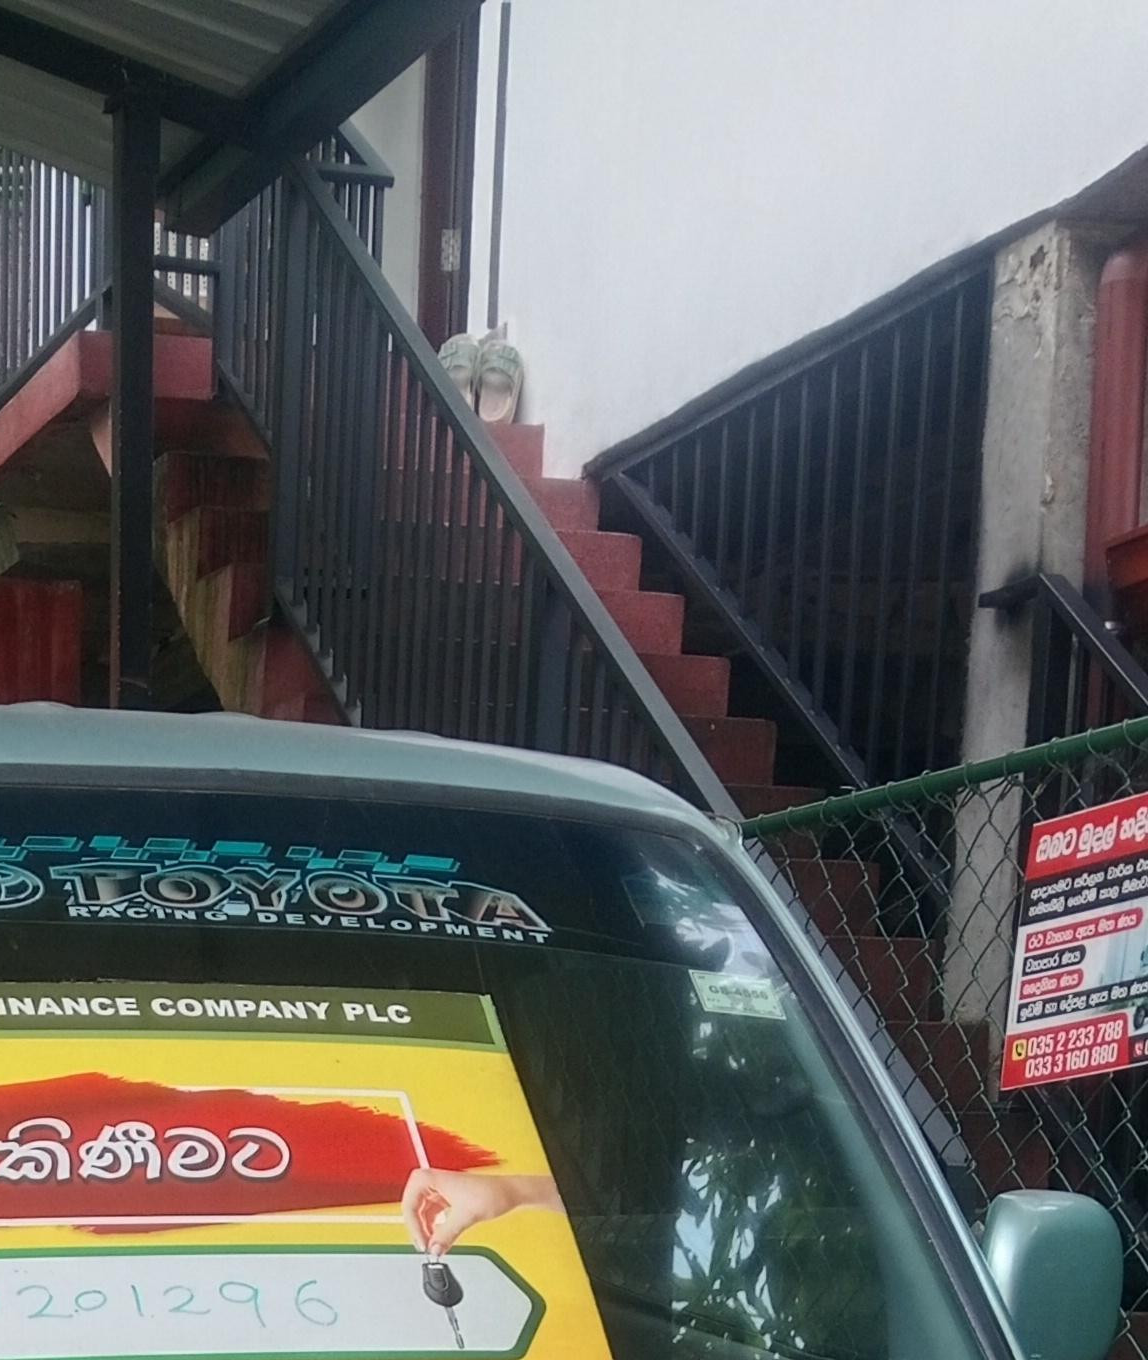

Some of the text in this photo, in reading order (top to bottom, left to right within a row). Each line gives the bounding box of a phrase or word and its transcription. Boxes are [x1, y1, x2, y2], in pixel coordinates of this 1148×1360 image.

[50, 861, 553, 932] TOYOTA
[68, 904, 549, 943] RACING DEVELOPMENT
[151, 1000, 331, 1021] COMPANY
[342, 1003, 412, 1024] PLC
[1028, 1020, 1123, 1057] 035 2 233 788
[1025, 1055, 1051, 1078] 033
[1053, 1053, 1063, 1072] 3
[1065, 1048, 1089, 1071] 160
[1091, 1043, 1118, 1065] 880
